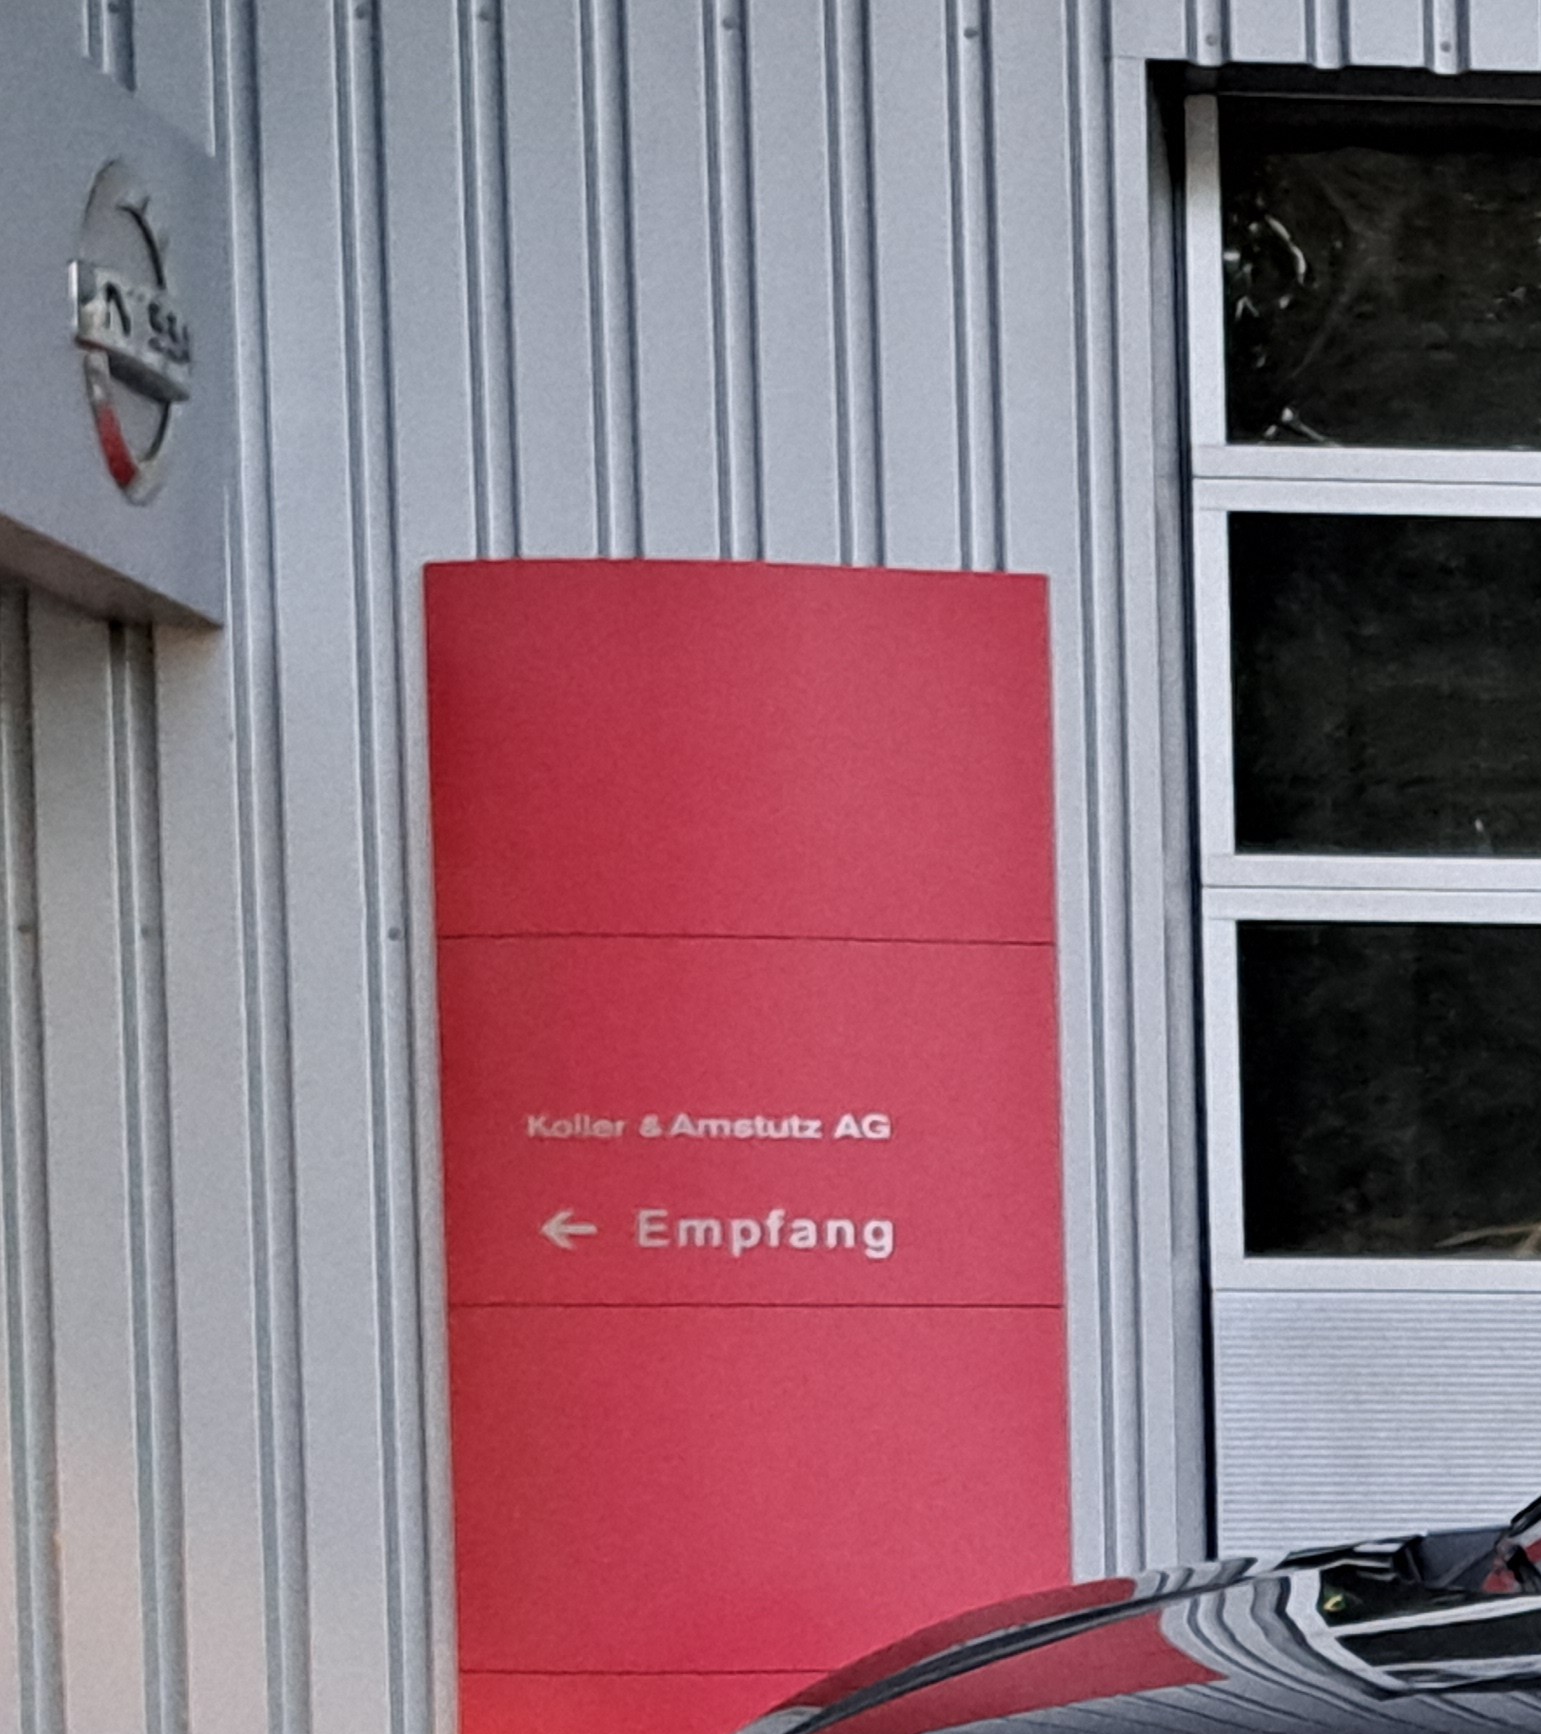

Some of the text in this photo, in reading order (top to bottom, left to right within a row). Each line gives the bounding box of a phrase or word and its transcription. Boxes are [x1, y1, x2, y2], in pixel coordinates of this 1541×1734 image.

[526, 1113, 891, 1140] Koller & Amstutz AG
[636, 1208, 895, 1258] Empfang
